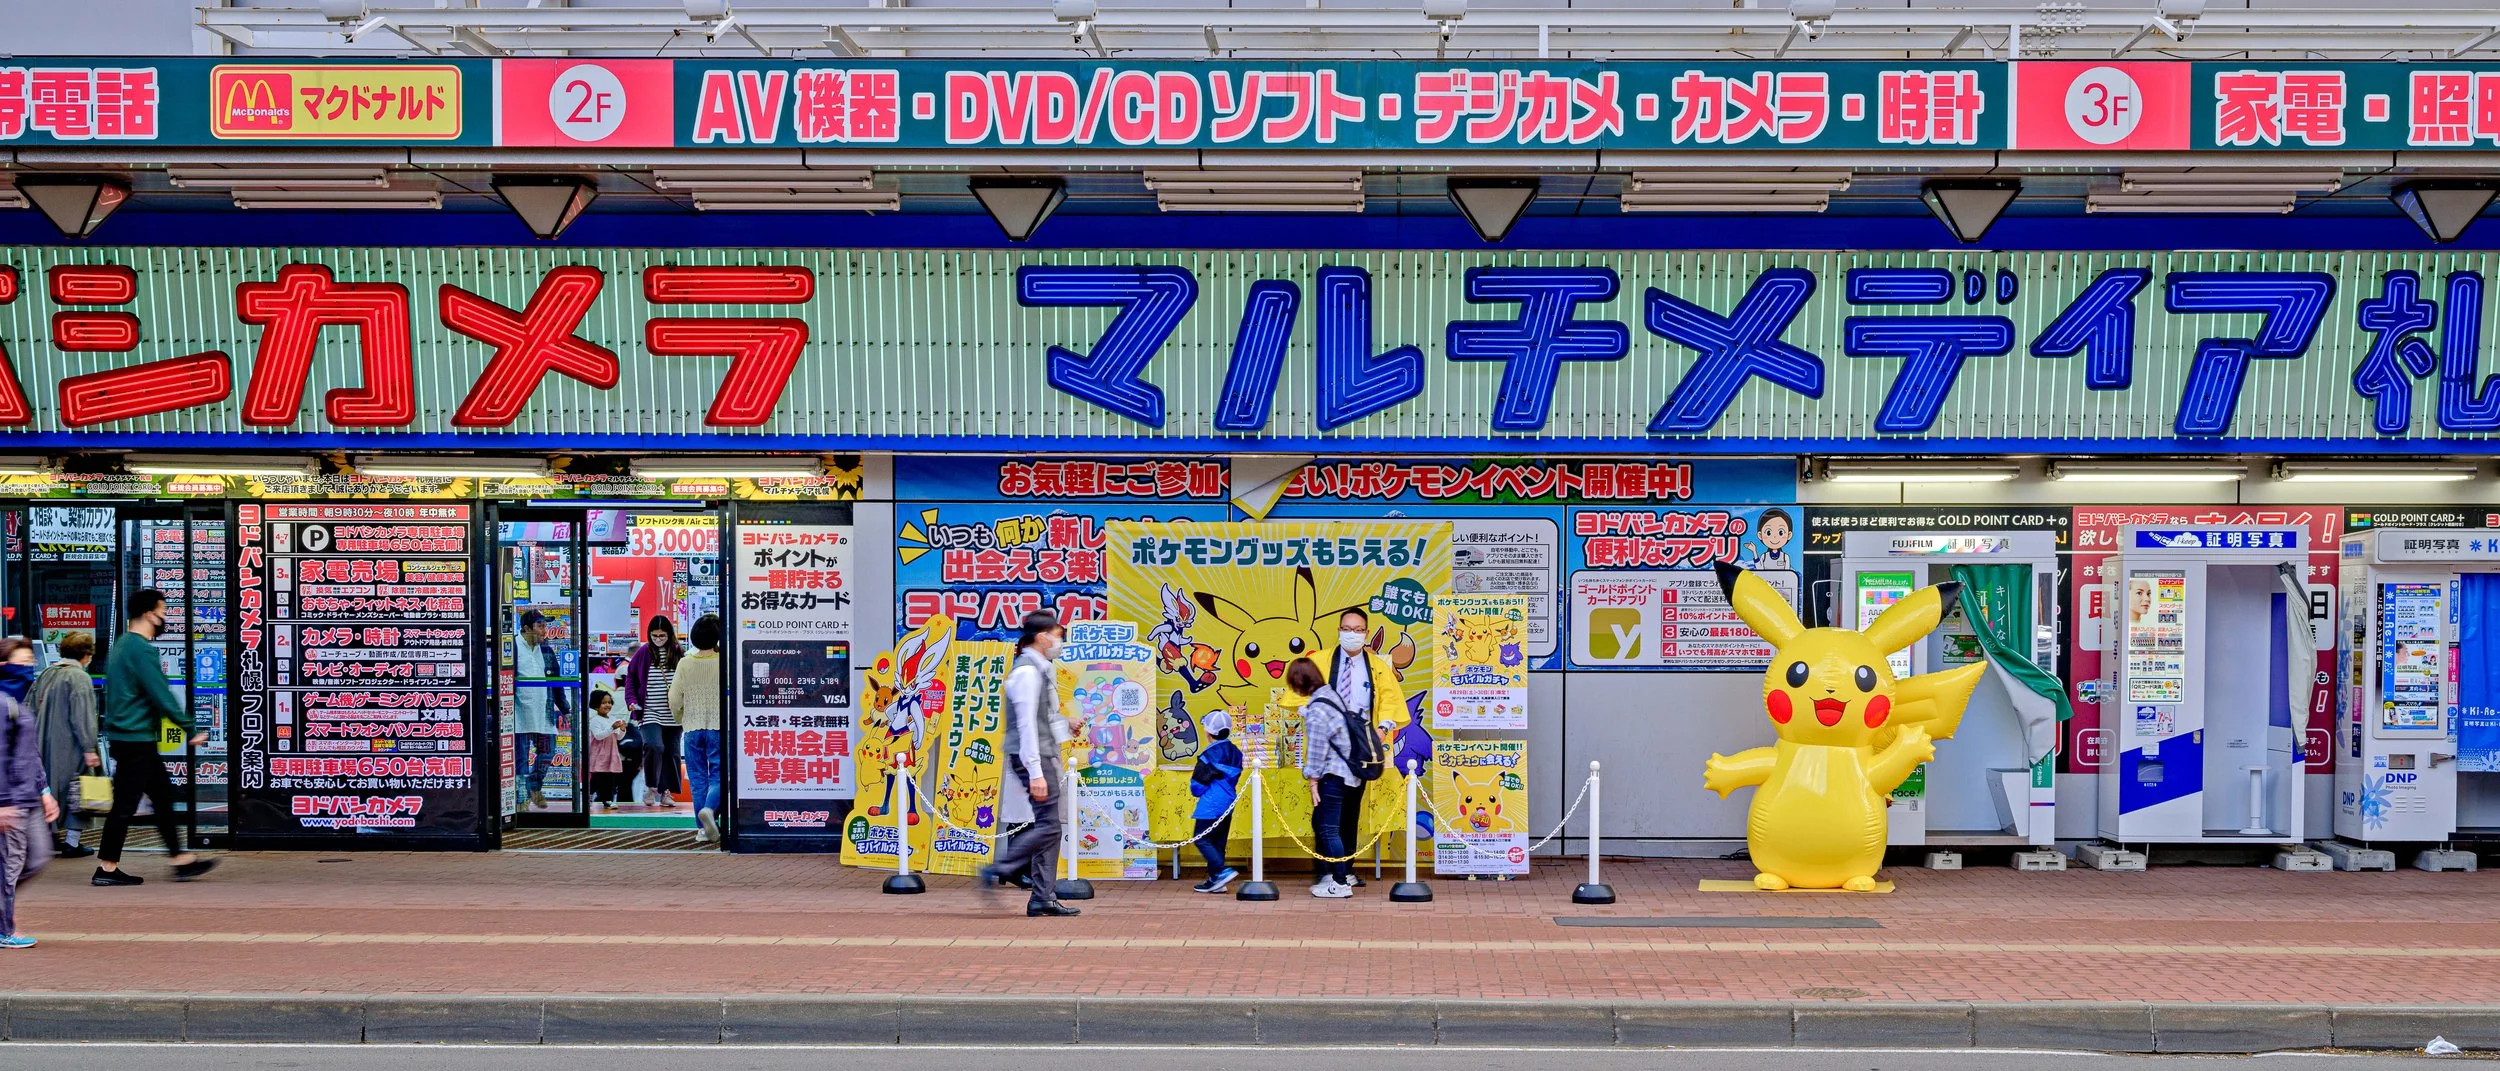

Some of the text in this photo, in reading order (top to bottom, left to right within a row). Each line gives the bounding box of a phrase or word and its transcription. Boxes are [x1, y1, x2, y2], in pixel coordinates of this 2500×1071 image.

[300, 84, 444, 122] マクドナルド
[565, 81, 611, 123] 2F
[2081, 82, 2128, 127] 3F
[232, 107, 290, 117] McDonald's
[1016, 264, 2500, 435] マルチメディア札
[759, 475, 837, 486] ヨドバシカメラ
[1000, 461, 1692, 498] お気軽にご参加い！ポケモンイベント開催中！
[87, 483, 108, 491] GOLD
[110, 483, 130, 491] POINT
[673, 485, 726, 494] 新規会員募集中
[763, 487, 830, 495] マルチメディア札幌
[418, 508, 457, 517] 年中無休
[2078, 513, 2168, 525] ヨドバシカメラ
[2170, 517, 2188, 525] なら
[2373, 513, 2399, 523] GOLD
[2401, 513, 2428, 523] POINT
[2430, 513, 2455, 523] CARD
[638, 517, 684, 526] ソフトバンク光
[1575, 511, 1747, 535] ヨドバシカメラの
[1812, 515, 2045, 527] 使えば使うほど便利でお得な GOLD POINT CARD
[155, 529, 208, 543] 家電場
[309, 529, 324, 547] P
[333, 526, 465, 538] ヨドバシカメラ専用駐車場
[743, 532, 848, 545] ヨドバシカメラの
[1892, 539, 1933, 548] FUJIFILM
[1947, 538, 2010, 550] 証明写真
[2206, 532, 2284, 548] 証明写真
[2404, 539, 2459, 550] 証明写真
[754, 547, 838, 568] ポイントが
[1131, 536, 1428, 568] ポケモングッズもらえる！
[1585, 537, 1740, 567] 便利なアプリ
[299, 560, 401, 583] 家電売場
[748, 569, 843, 590] 一番貯まる
[1384, 584, 1426, 605] 誰でも
[1577, 584, 1657, 595] ゴールドポイント
[302, 597, 464, 611] おもちゃ・フィットネス・化粧品
[741, 590, 851, 611] お得なカード
[1587, 594, 1648, 606] カードアプリ
[46, 607, 92, 619] 銀行ATM
[1457, 607, 1504, 616] イベント開催！
[1664, 608, 1676, 620] 2
[1995, 585, 2006, 645] キレイな
[758, 620, 783, 629] GOLD
[786, 620, 813, 629] POINT
[815, 620, 840, 629] CARD
[301, 627, 401, 646] カメラ・時計
[1072, 623, 1134, 643] ポケモン
[1664, 626, 1675, 638] 3
[1060, 644, 1152, 662] モバイルガチャ
[1664, 643, 1676, 655] 4
[302, 662, 413, 677] テレビ・オーディオ
[1465, 664, 1493, 673] ポケモン
[774, 677, 793, 685] 0001
[797, 677, 816, 685] 2345
[820, 677, 839, 685] 6789
[1450, 673, 1510, 686] モバイルガチャ
[822, 694, 847, 704] VISA
[968, 656, 988, 733] イベント
[984, 655, 1005, 733] ポケモン
[420, 709, 461, 721] 文房具
[948, 655, 971, 769] 実施チュウ！
[744, 715, 850, 728] 入会費・年会費無料
[166, 728, 182, 744] 階
[304, 723, 464, 738] スマートフォン・パソコン売場
[743, 729, 850, 757] 新規会員
[270, 757, 472, 777] 専用駐車場650台完備！
[1438, 752, 1521, 768] ピカチュウに会える！
[754, 757, 840, 785] 募集中！
[269, 778, 472, 789] お車でも安心してお買い物いただけます！
[2385, 773, 2418, 784] DNP
[292, 796, 423, 815] ヨドバシカメラ
[2343, 791, 2355, 806] DNP
[300, 816, 415, 829] www.yodobashi.com
[764, 810, 829, 822] ヨドバシカメラ
[856, 840, 914, 855] モバイルガャ
[935, 839, 990, 855] モバイルガチャ
